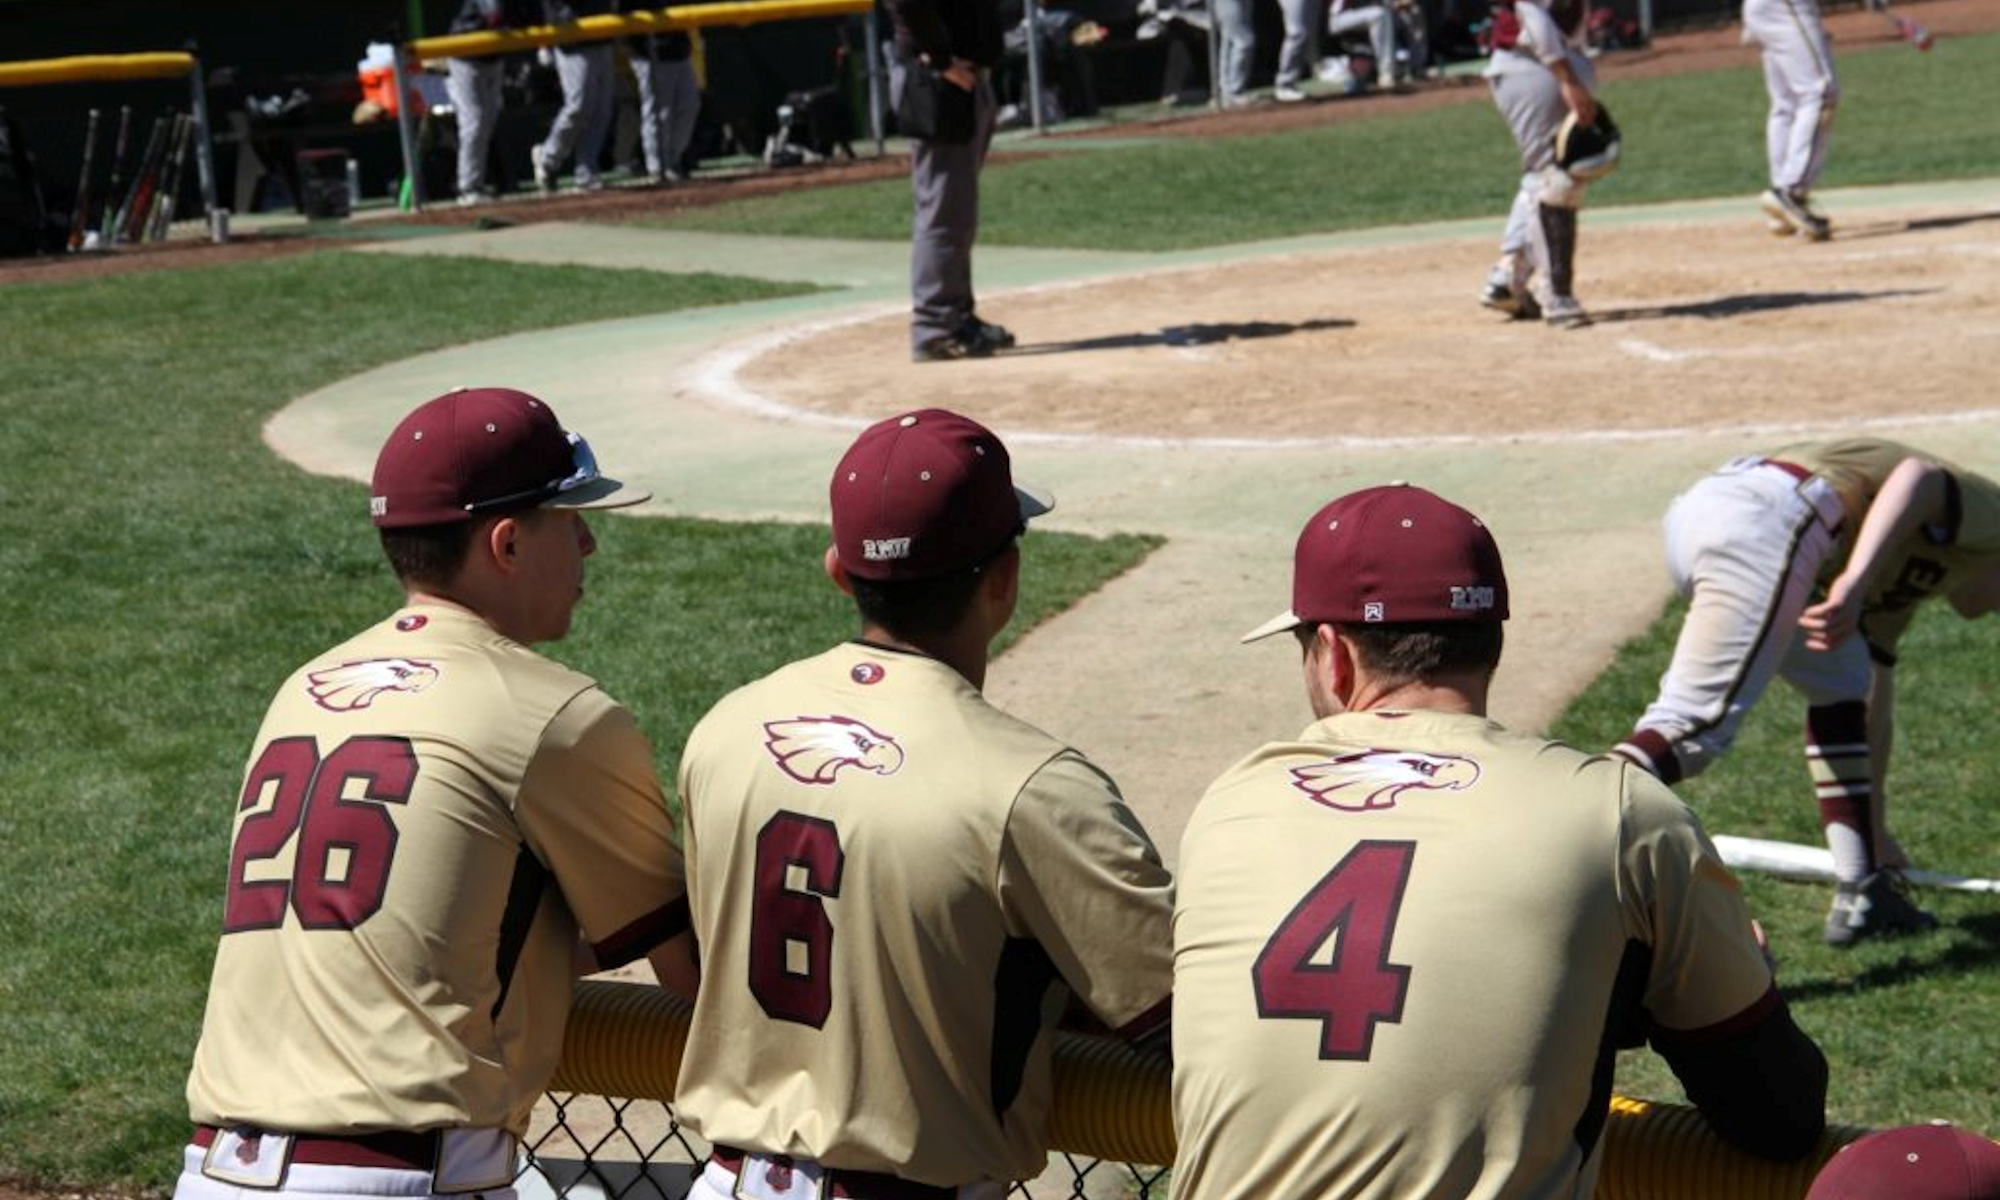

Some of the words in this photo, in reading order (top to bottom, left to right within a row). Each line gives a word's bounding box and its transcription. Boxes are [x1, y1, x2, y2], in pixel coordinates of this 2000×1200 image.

[223, 734, 420, 935] 26
[748, 808, 845, 1031] 6
[1251, 839, 1417, 1062] 4
